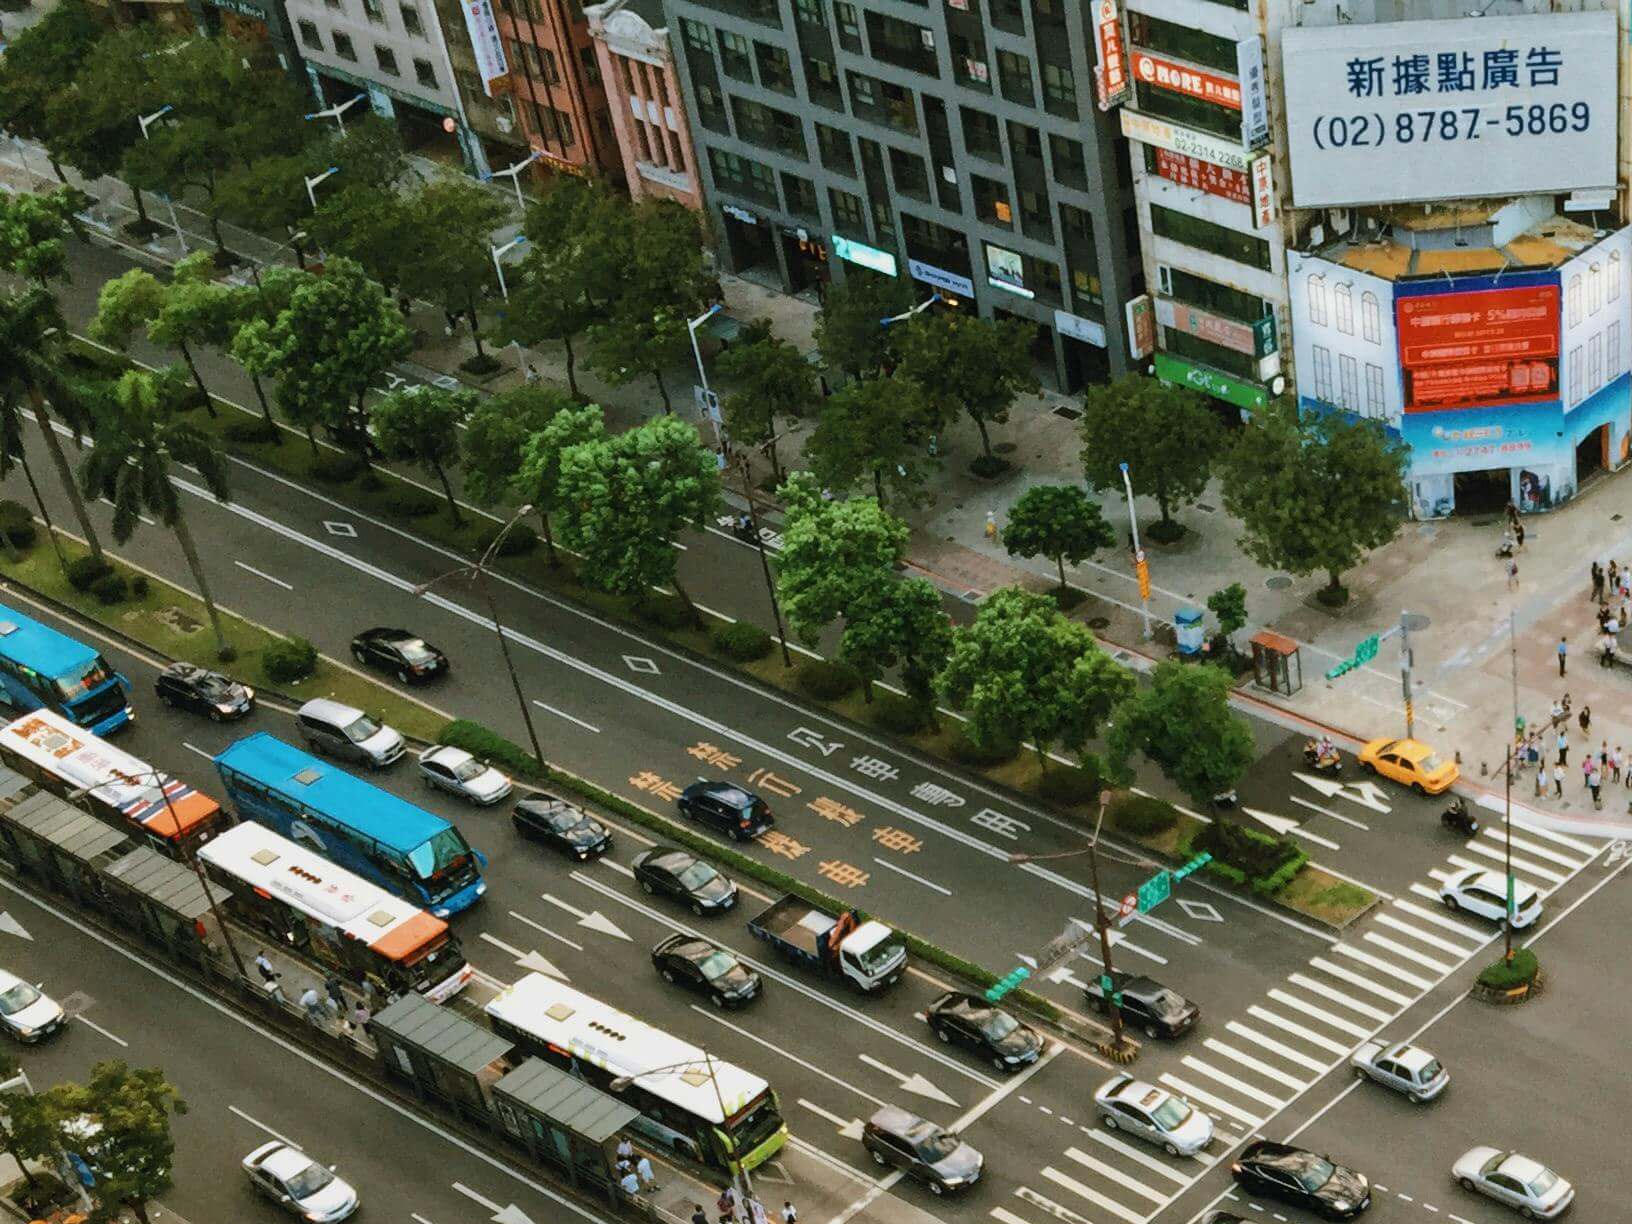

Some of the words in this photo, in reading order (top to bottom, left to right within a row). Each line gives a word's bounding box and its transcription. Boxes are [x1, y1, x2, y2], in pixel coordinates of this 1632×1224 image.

[1346, 46, 1563, 98] 新據點廣告
[627, 770, 872, 888] 禁機車
[686, 741, 925, 855] 禁行機車
[786, 726, 1031, 840] 公車專用
